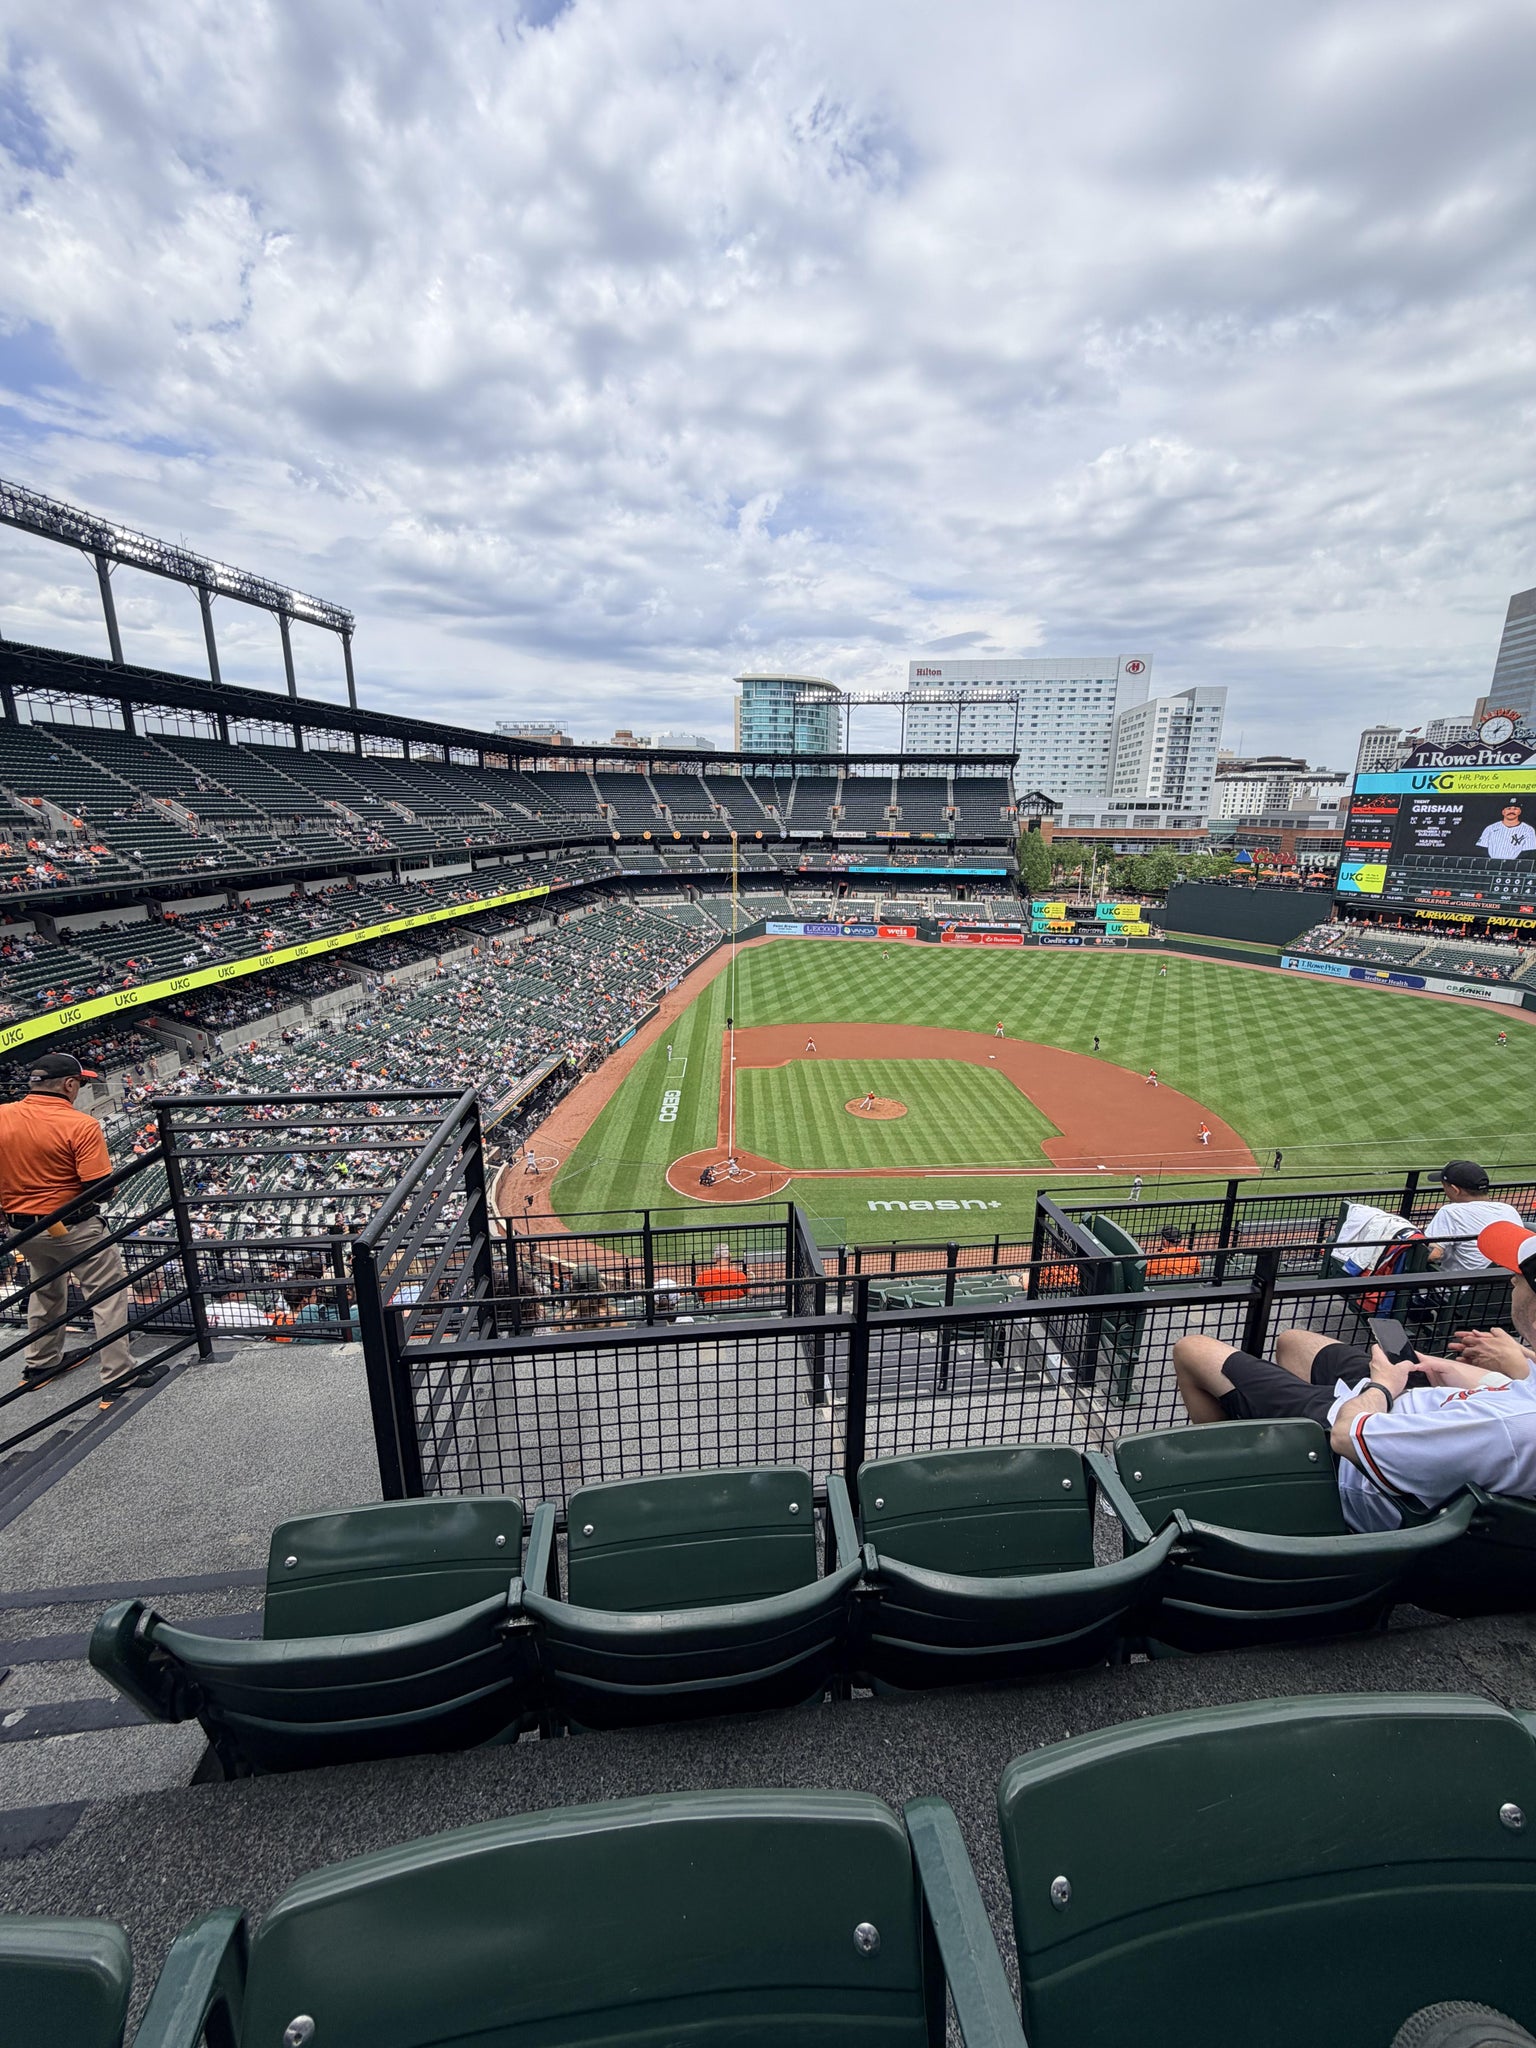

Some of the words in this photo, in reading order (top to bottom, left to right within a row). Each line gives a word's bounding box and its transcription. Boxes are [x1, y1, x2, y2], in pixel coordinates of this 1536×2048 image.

[916, 668, 942, 676] Hilton
[1477, 750, 1522, 765] Price
[1411, 774, 1454, 790] UKG
[1412, 805, 1463, 813] GRISHAM
[1253, 847, 1297, 864] Coors
[1301, 854, 1339, 867] LIGH
[1341, 872, 1363, 881] UKG
[1416, 910, 1475, 923] PUREWAGER
[327, 939, 339, 948] UKG
[295, 947, 308, 956] UKG
[259, 956, 274, 966] UKG
[218, 966, 235, 978] UKG
[1325, 964, 1341, 972] Price
[170, 978, 190, 992] UKG
[115, 992, 138, 1007] UKG
[59, 1009, 82, 1025] UKG
[2, 1028, 24, 1046] UKG
[658, 1090, 681, 1122] GEICO
